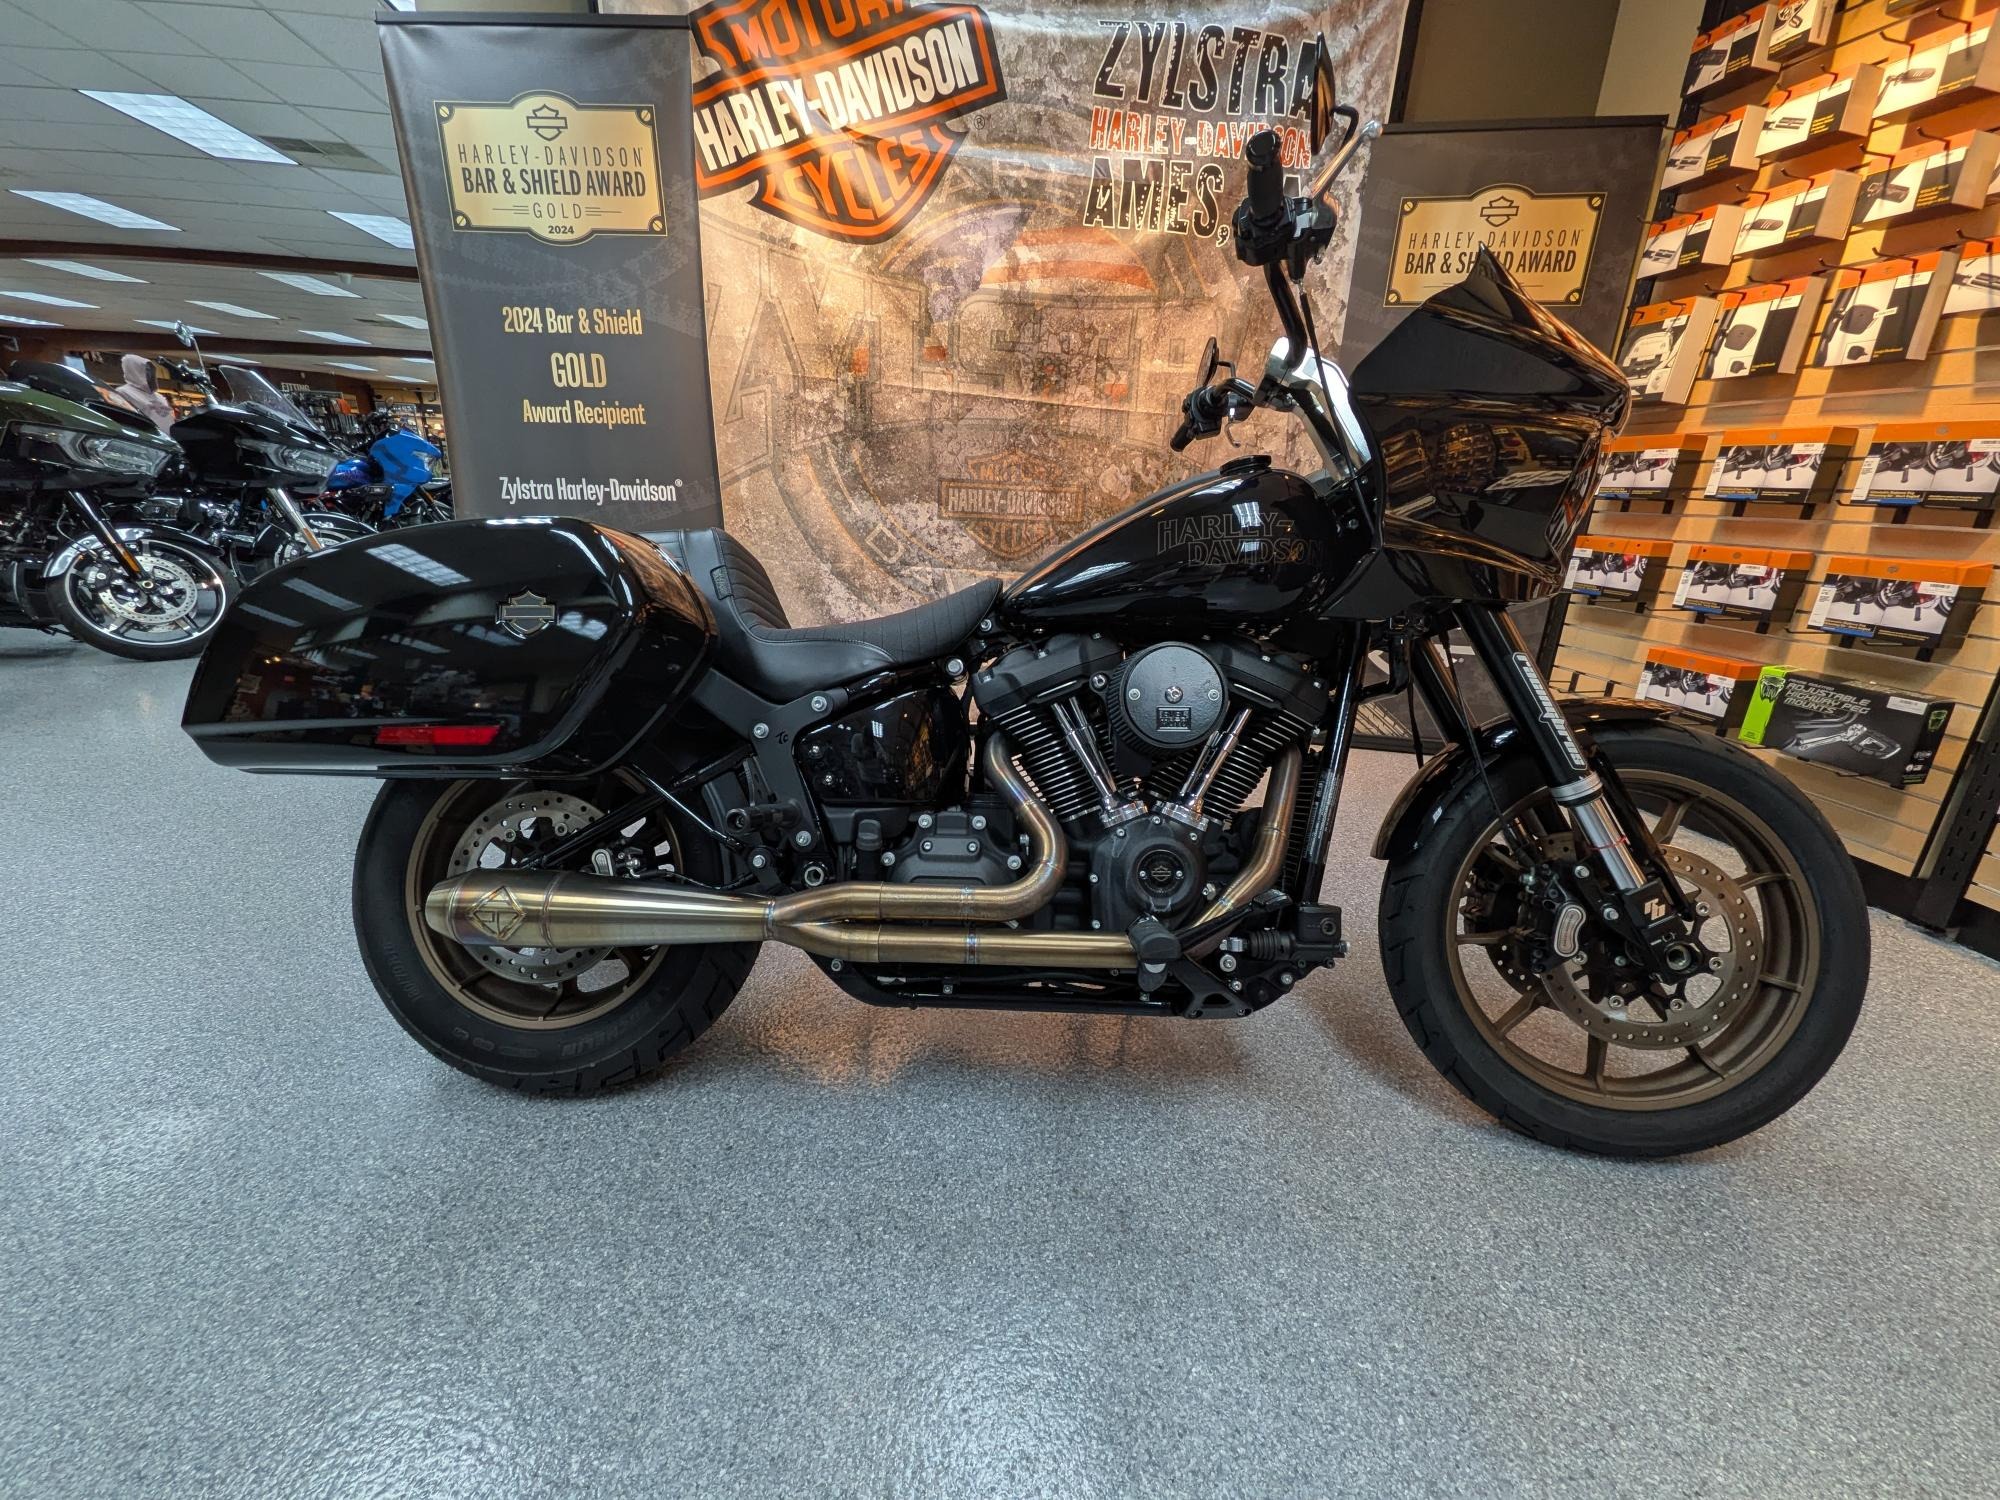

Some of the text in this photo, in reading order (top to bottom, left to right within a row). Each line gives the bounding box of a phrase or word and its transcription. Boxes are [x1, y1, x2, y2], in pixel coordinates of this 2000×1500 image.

[1093, 20, 1314, 120] ZYLSTRA
[694, 19, 979, 171] HARLEY-DAVIDSON
[1089, 106, 1312, 169] HARLEY-DAVON
[458, 143, 643, 166] HARLEY-DAVIDSON
[461, 167, 647, 197] BAR & SHIELD AWARD
[783, 130, 932, 221] CYCLES
[532, 203, 584, 219] GOLD
[1083, 157, 1230, 248] AMES,
[547, 225, 575, 235] 2024
[1404, 250, 1577, 275] BAR & SHD AWARD
[502, 306, 643, 335] 2024 Bar & Shield
[550, 353, 608, 388] GOLD
[523, 399, 647, 430] Award Recipient
[499, 477, 554, 504] Zylstra
[1157, 512, 1296, 555] HARLEY-
[1187, 538, 1328, 567] DAVIDSON
[1783, 697, 1837, 714] MOUNTS
[1785, 689, 1841, 708] HIGHWAY
[1840, 702, 1871, 714] PEG
[1786, 682, 1872, 707] ADJUSTABLE
